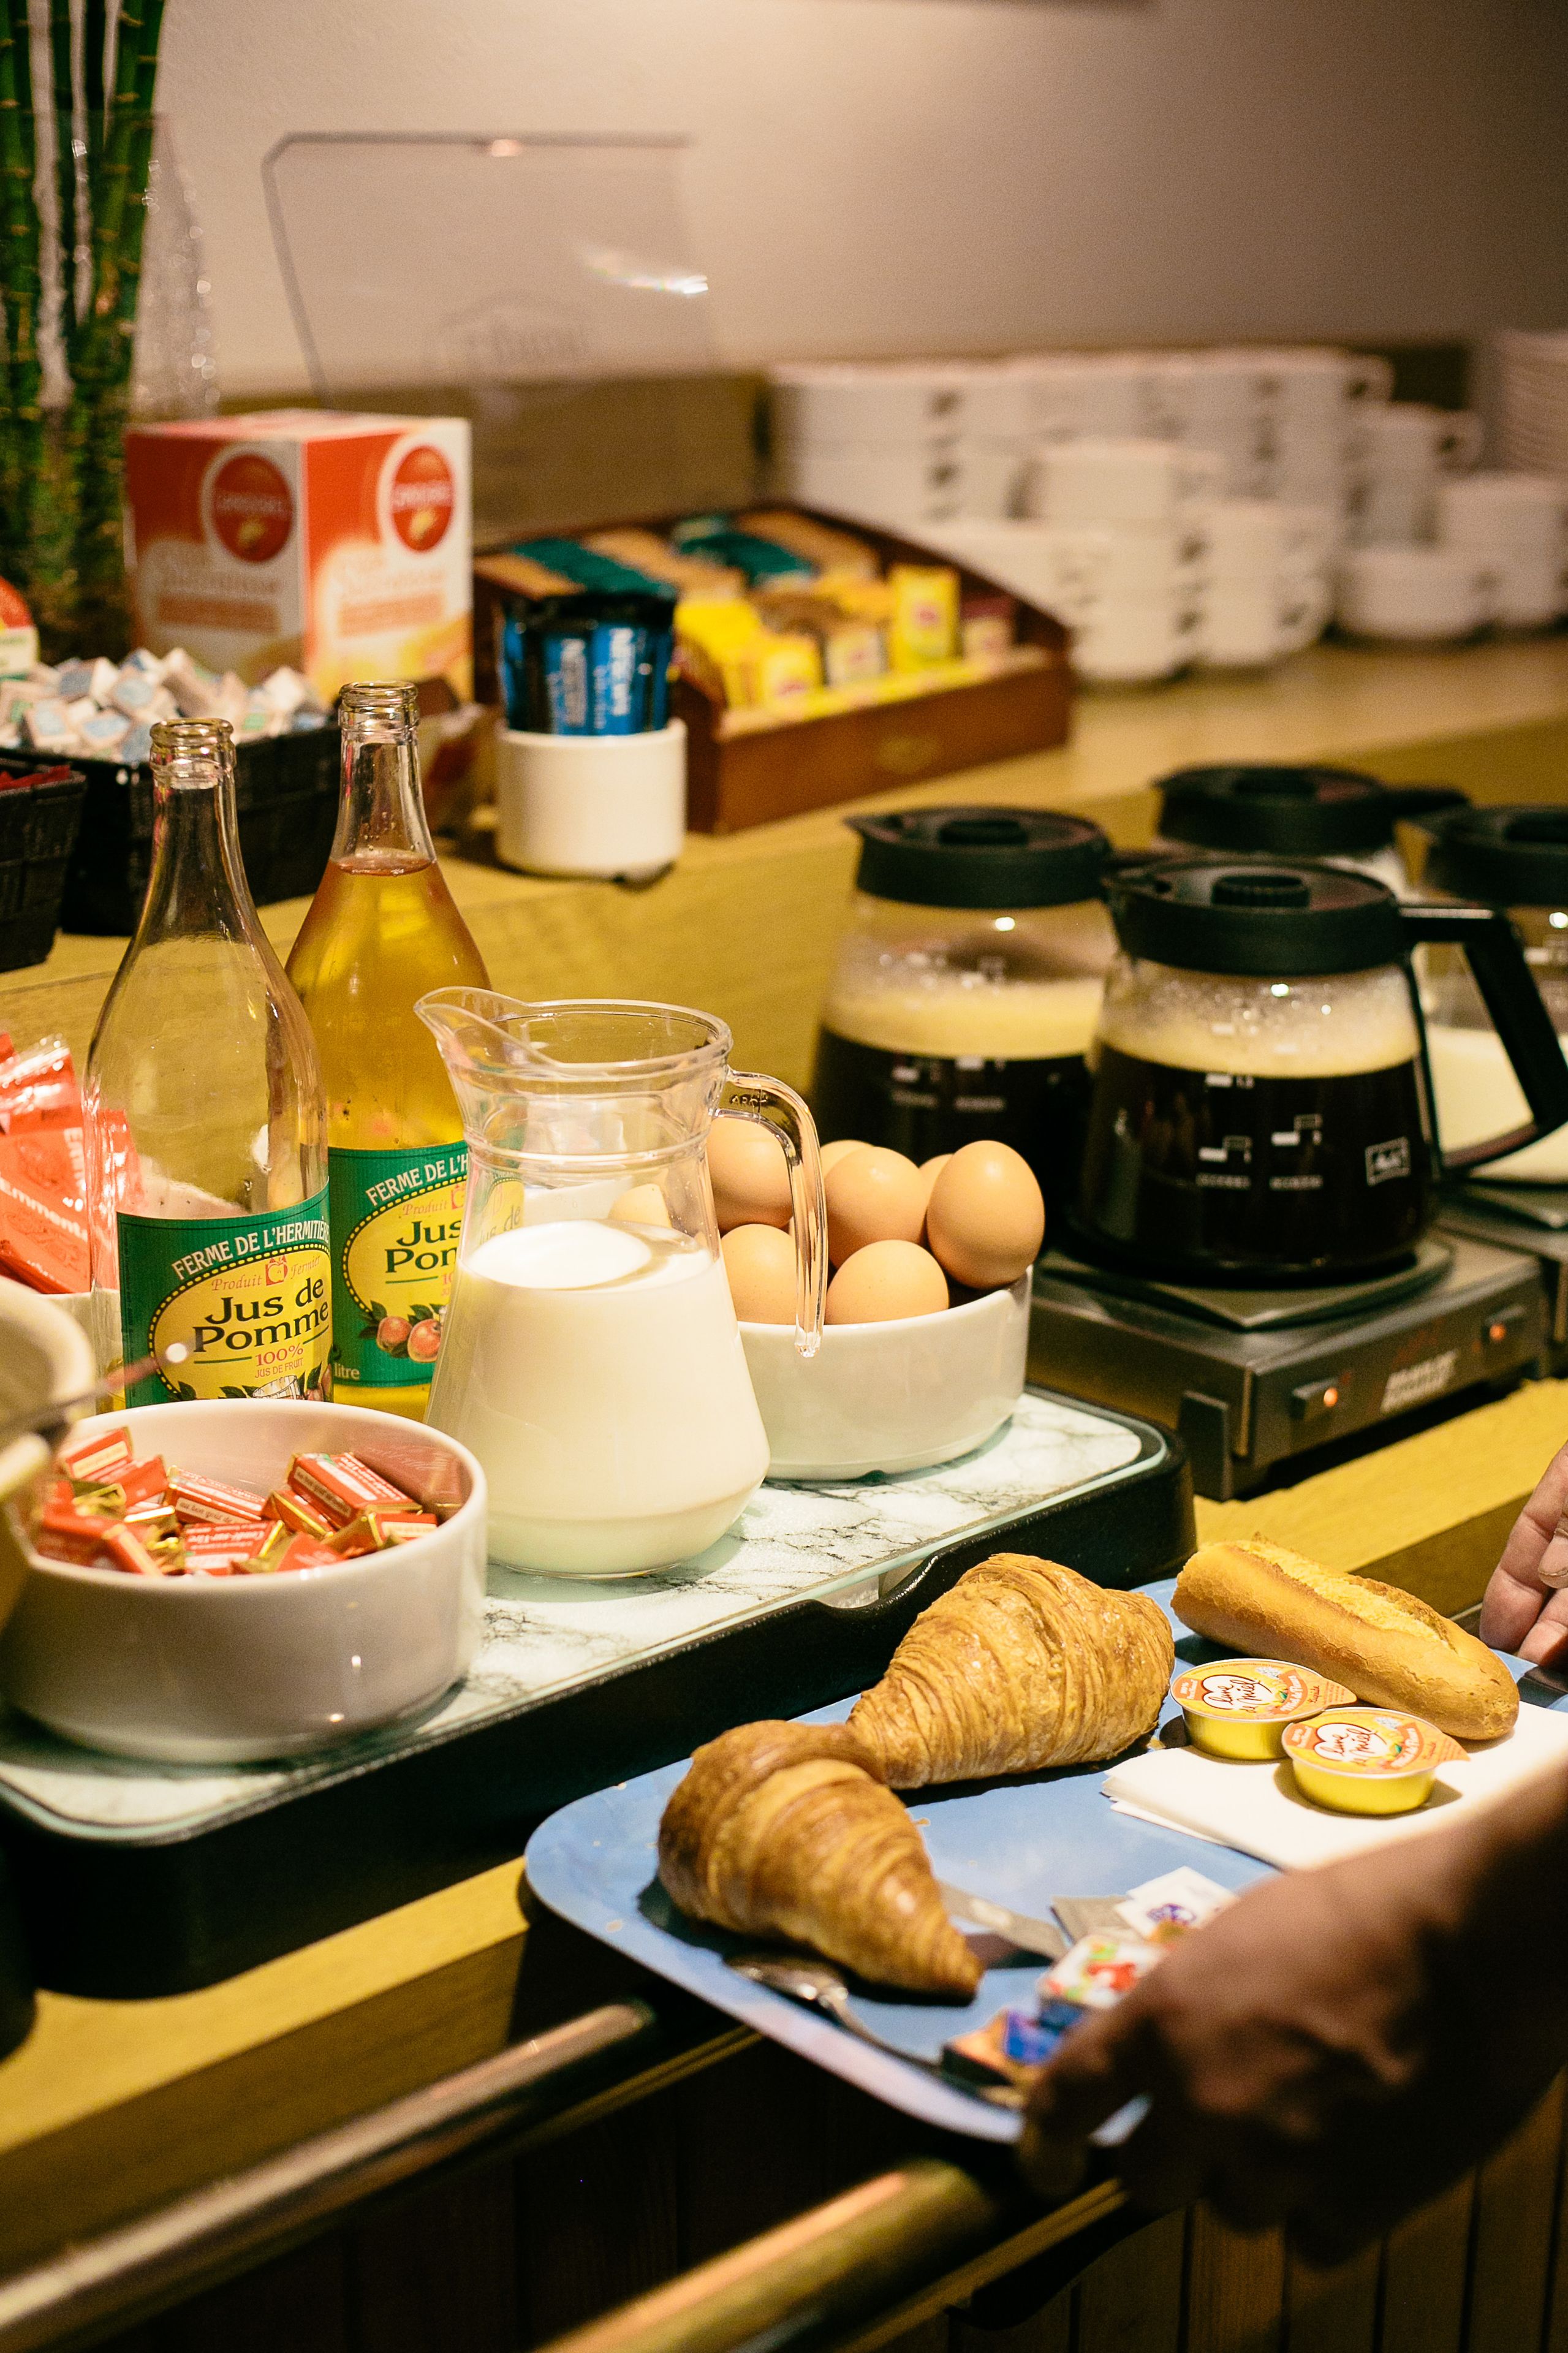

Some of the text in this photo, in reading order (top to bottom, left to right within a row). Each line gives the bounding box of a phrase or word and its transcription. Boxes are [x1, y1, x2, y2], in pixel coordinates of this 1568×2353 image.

[365, 1168, 423, 1207] FERME
[424, 1160, 447, 1183] DE
[403, 1199, 448, 1216] Produit
[172, 1240, 233, 1280] FERME
[234, 1232, 260, 1256] DE
[211, 1255, 320, 1291] Produit Fermier
[205, 1278, 324, 1325] Jus de
[192, 1302, 329, 1352] Pomme
[255, 1358, 304, 1379] JUS DE FRUIT
[256, 1343, 304, 1366] 100%
